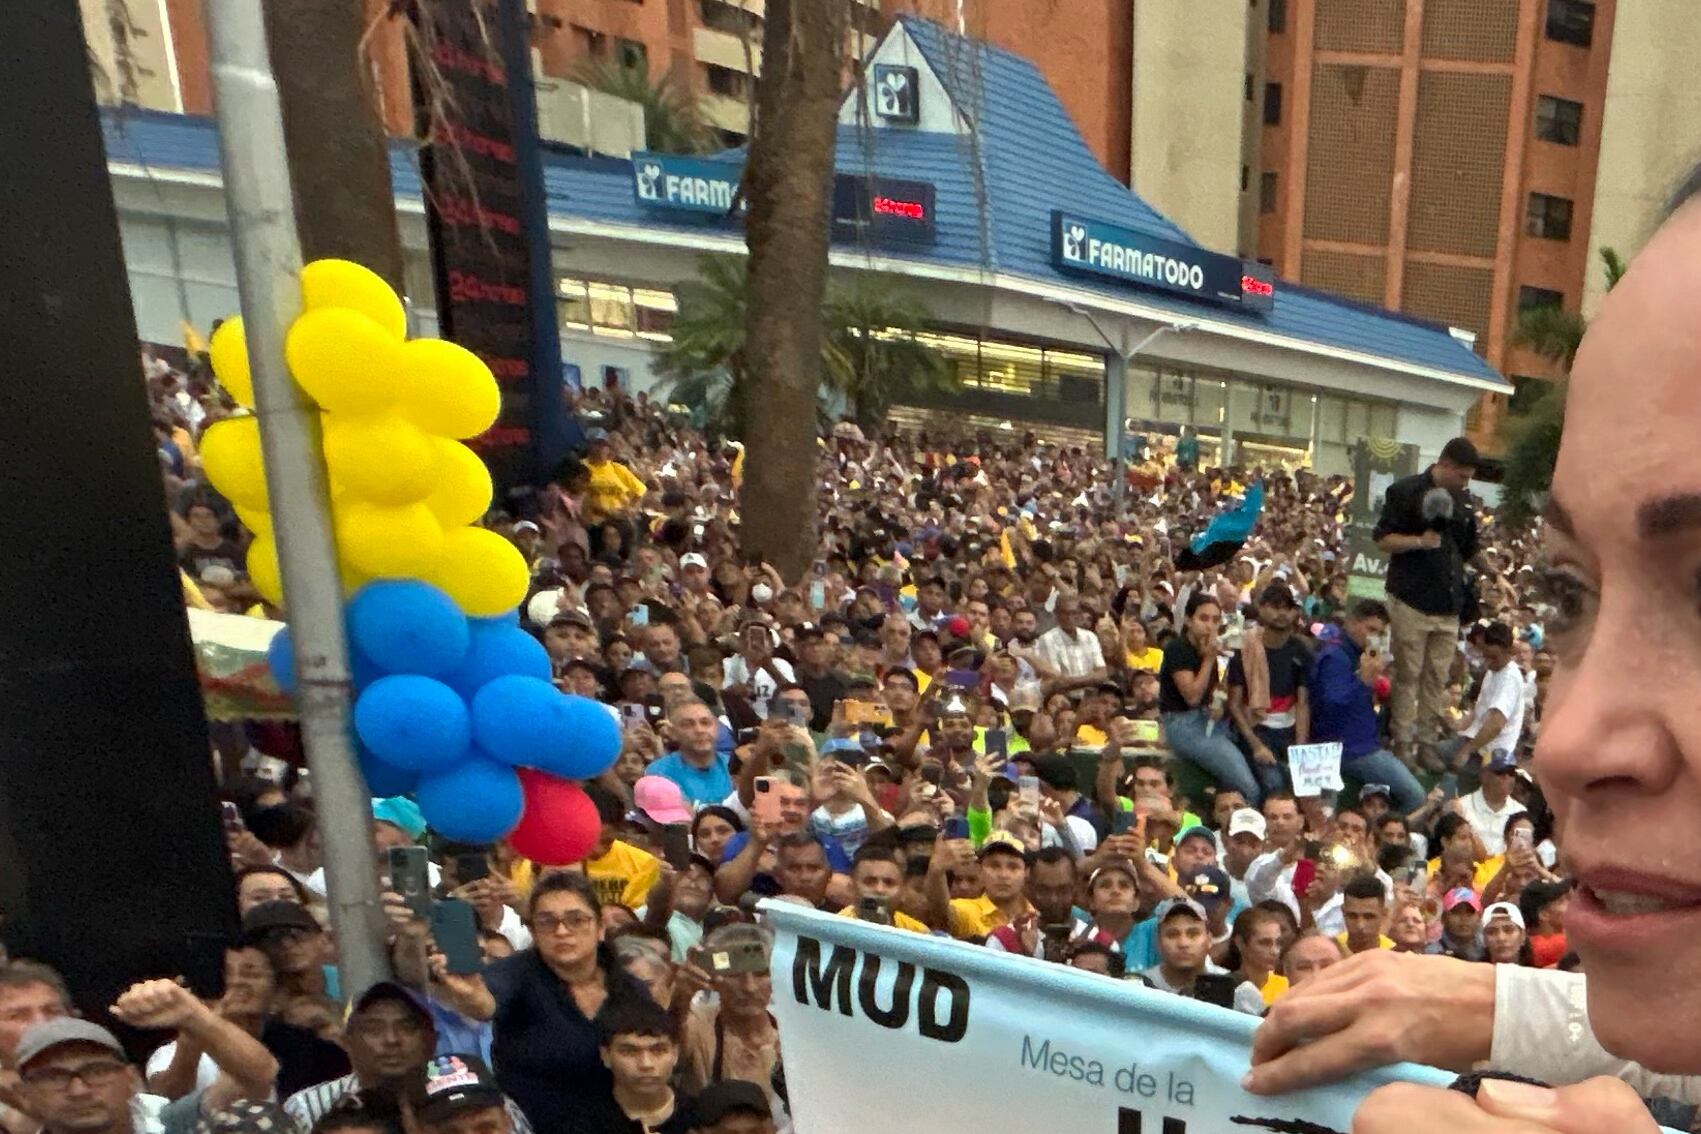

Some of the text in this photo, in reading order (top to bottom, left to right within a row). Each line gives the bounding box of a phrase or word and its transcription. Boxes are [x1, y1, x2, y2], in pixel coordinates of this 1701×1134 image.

[1088, 238, 1204, 290] FARMATODO
[792, 935, 970, 1043] MUD
[1021, 1033, 1195, 1106] Mesa de la
